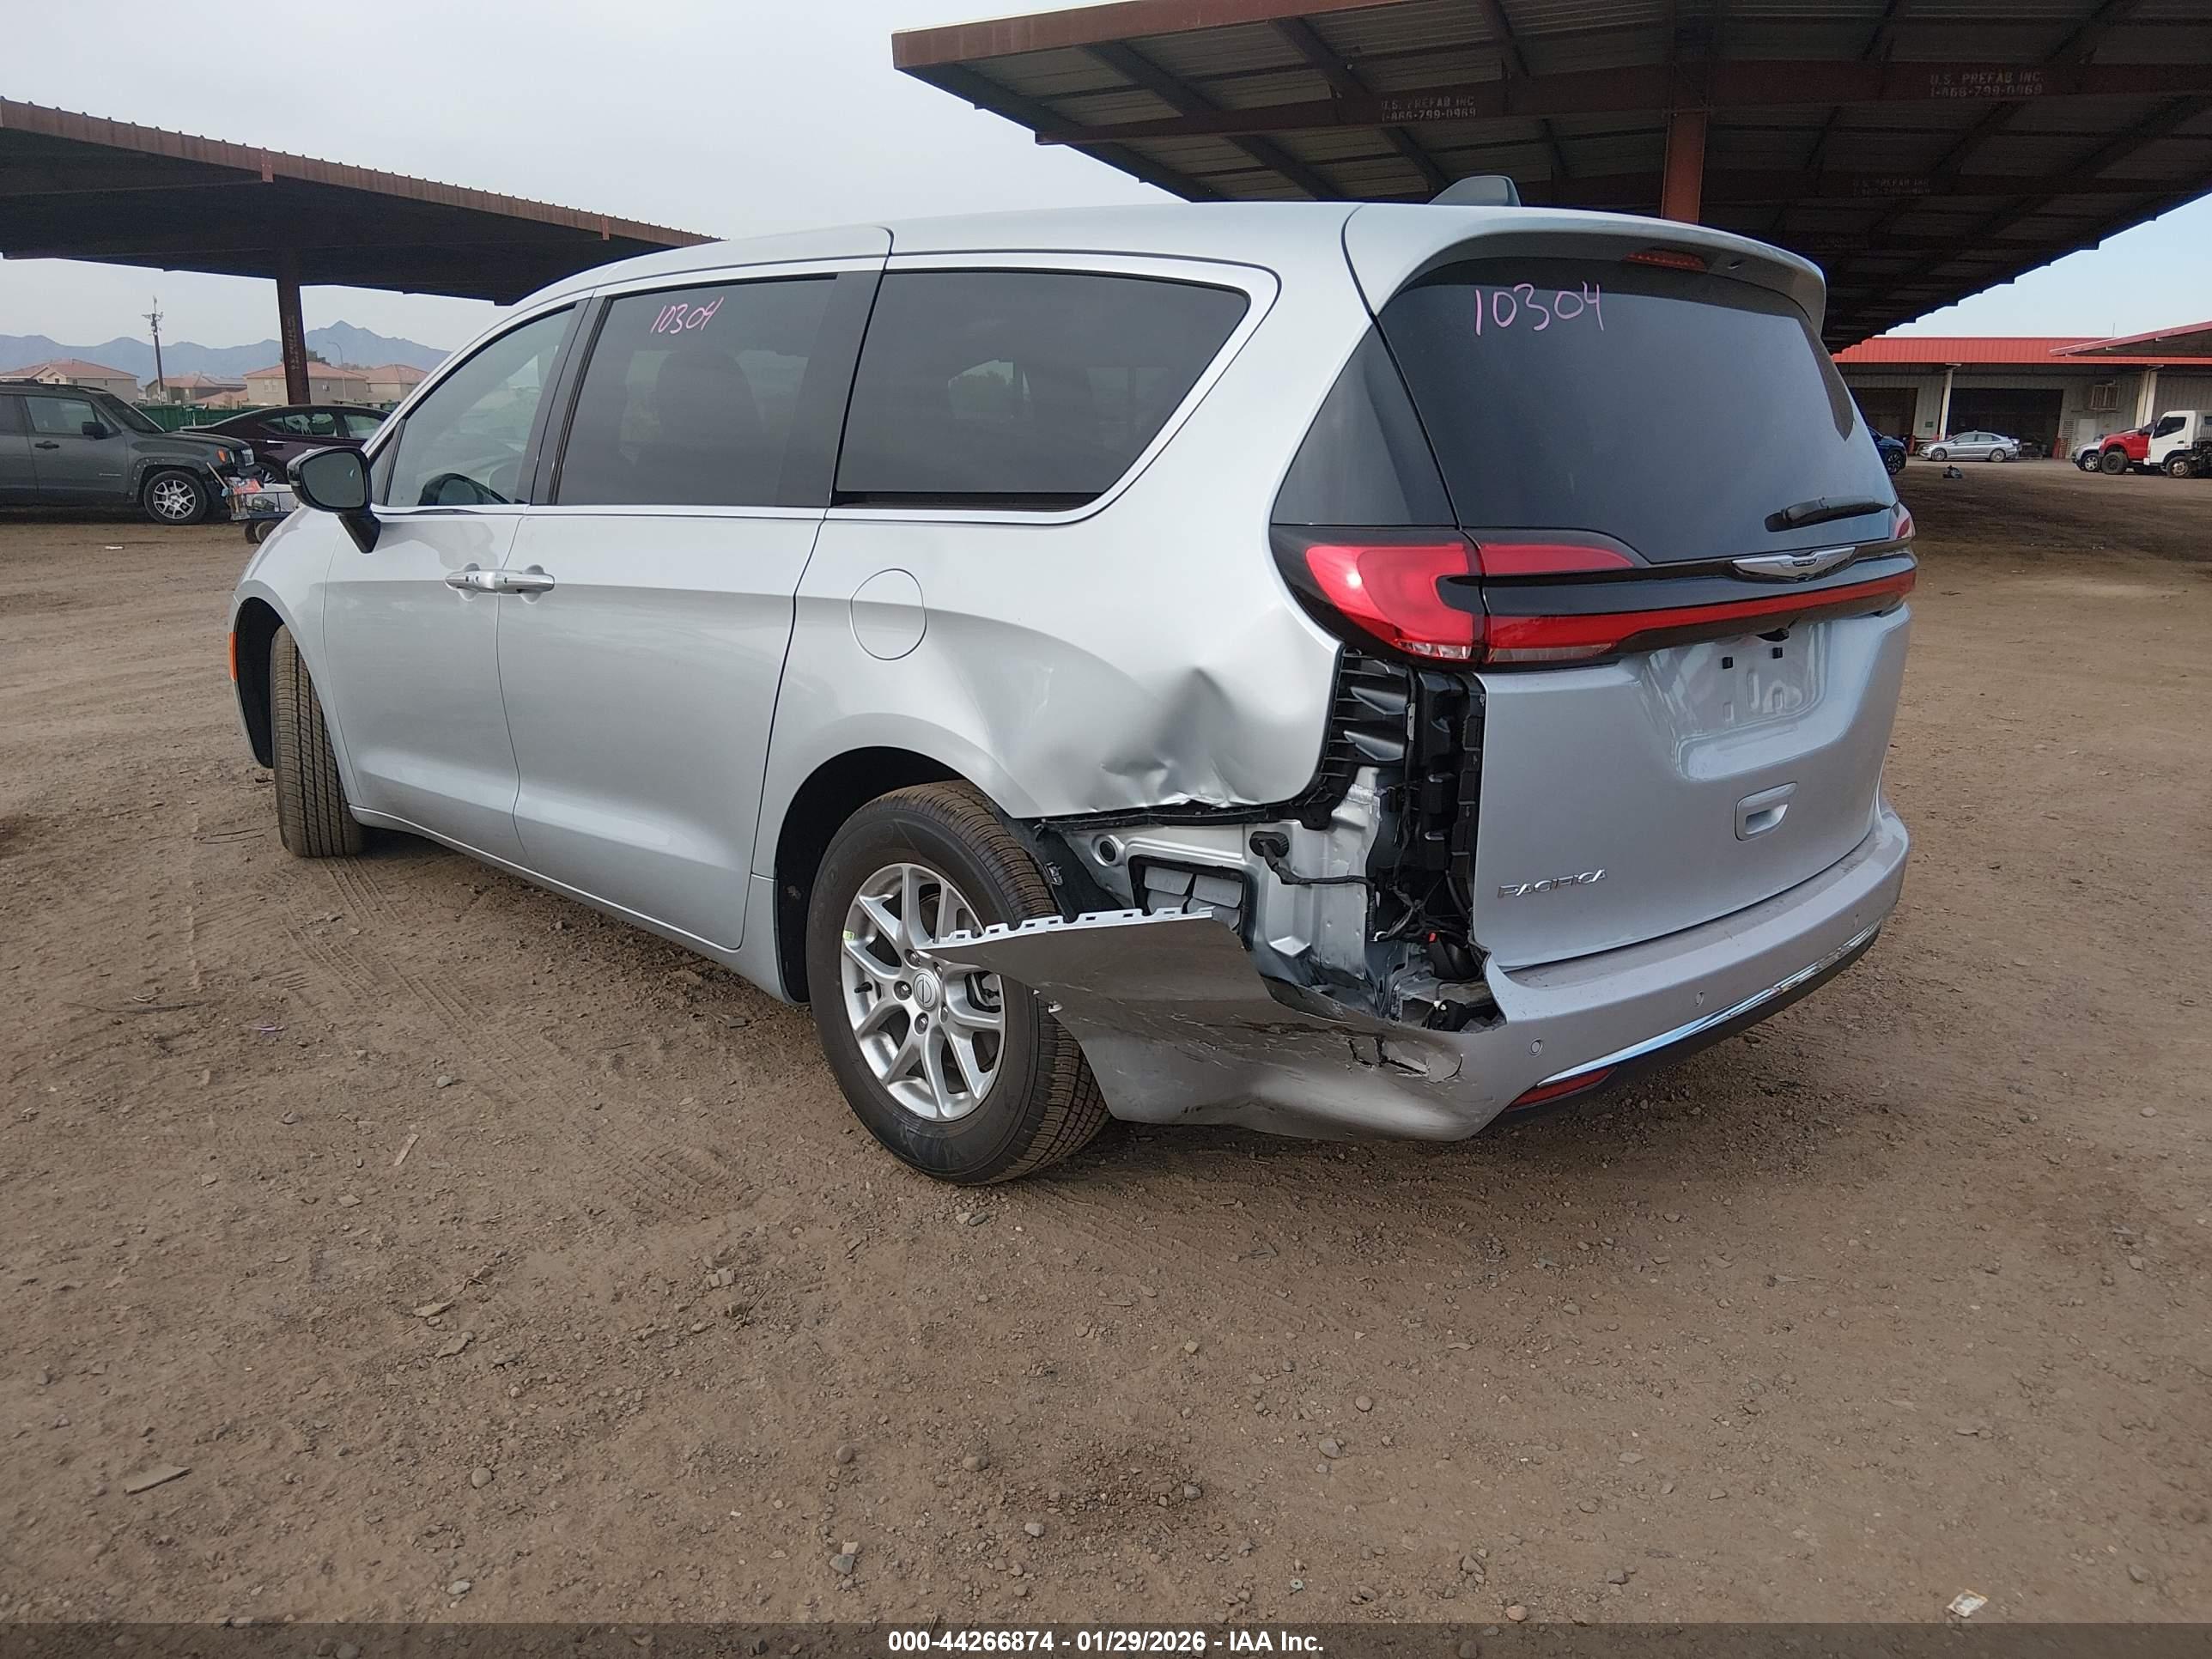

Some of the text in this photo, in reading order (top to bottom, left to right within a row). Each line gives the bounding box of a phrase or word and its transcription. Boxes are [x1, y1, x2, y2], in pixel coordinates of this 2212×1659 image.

[1961, 71, 2014, 84] PREFAB
[650, 296, 725, 334] 10304
[1474, 281, 1605, 337] 10304
[1497, 868, 1608, 898] PACIFICA
